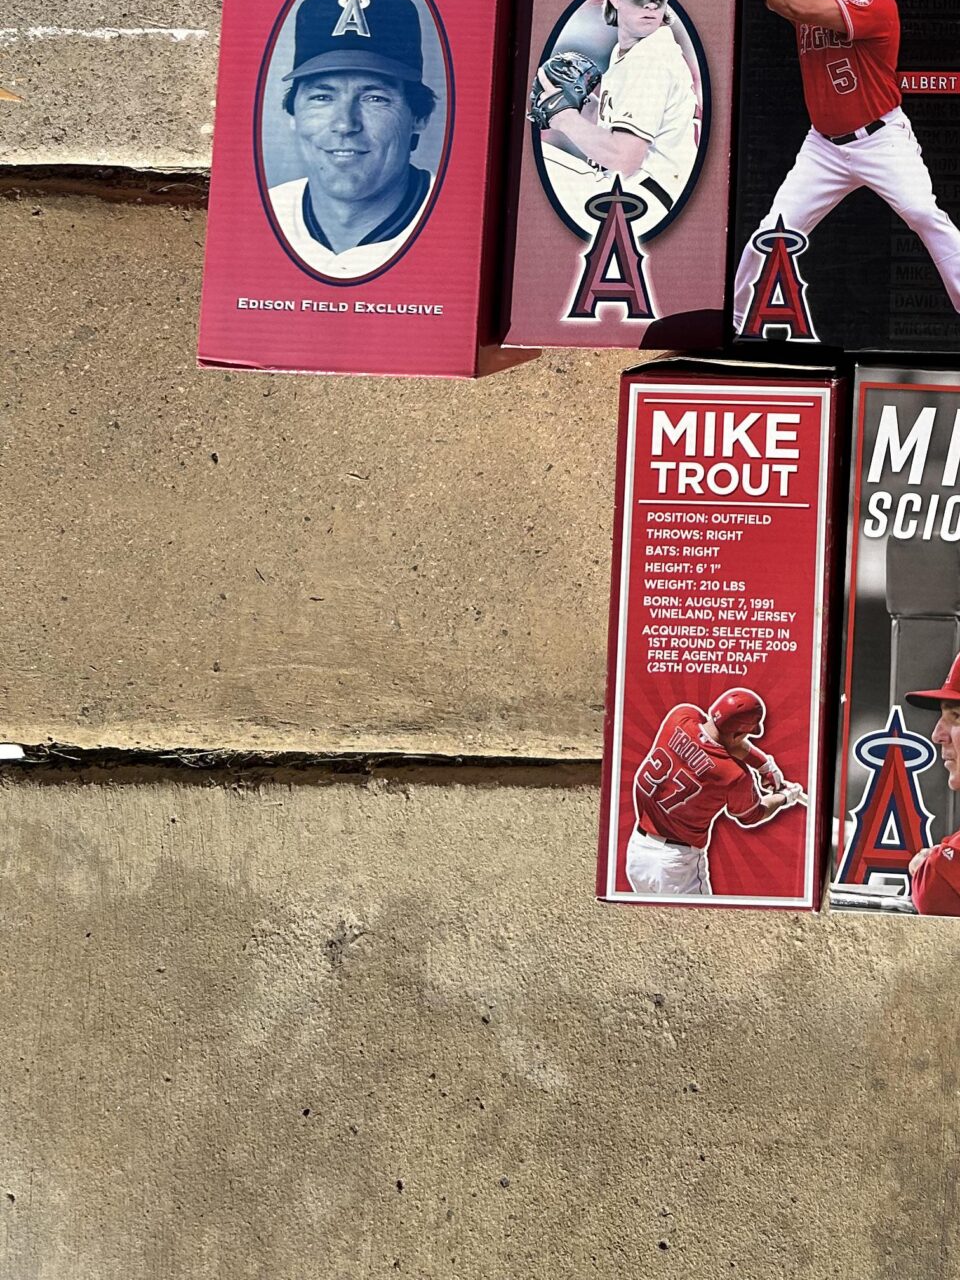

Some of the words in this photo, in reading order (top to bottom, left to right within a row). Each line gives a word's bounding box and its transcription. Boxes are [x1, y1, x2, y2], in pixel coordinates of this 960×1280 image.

[826, 58, 858, 95] 5
[900, 76, 957, 91] ALBERT
[651, 409, 802, 460] MIKE
[650, 461, 798, 496] TROUT
[646, 512, 708, 523] POSITION:
[711, 514, 771, 524] OUTFIELD
[647, 529, 703, 539] THROWS:
[706, 530, 743, 541] RIGHT
[645, 546, 679, 556] BATS:
[683, 547, 720, 557] RIGHT
[645, 562, 693, 573] HEIGHT:
[644, 579, 697, 590] WEIGHT:
[701, 581, 720, 590] 210
[723, 581, 746, 591] LBS
[643, 596, 682, 606] BORN:
[685, 598, 734, 608] AUGUST
[738, 599, 747, 610] 7,
[750, 599, 774, 609] 1991
[650, 609, 715, 621] VINELAND,
[718, 611, 748, 620] NEW
[751, 612, 796, 622] JERSEY
[642, 625, 709, 636] ACQUIRED:
[712, 627, 774, 638] SELECTED
[778, 629, 790, 638] IN
[648, 638, 667, 647] 1ST
[670, 638, 715, 648] ROUND
[719, 640, 736, 649] OF
[739, 640, 762, 650] THE
[766, 641, 797, 651] 2009
[648, 650, 679, 660] FREE
[682, 651, 724, 661] AGENT
[727, 652, 768, 663] DRAFT
[647, 663, 682, 673] (25TH
[686, 664, 748, 675] OVERALL)
[668, 726, 716, 777] TROUT
[636, 747, 703, 814] 27
